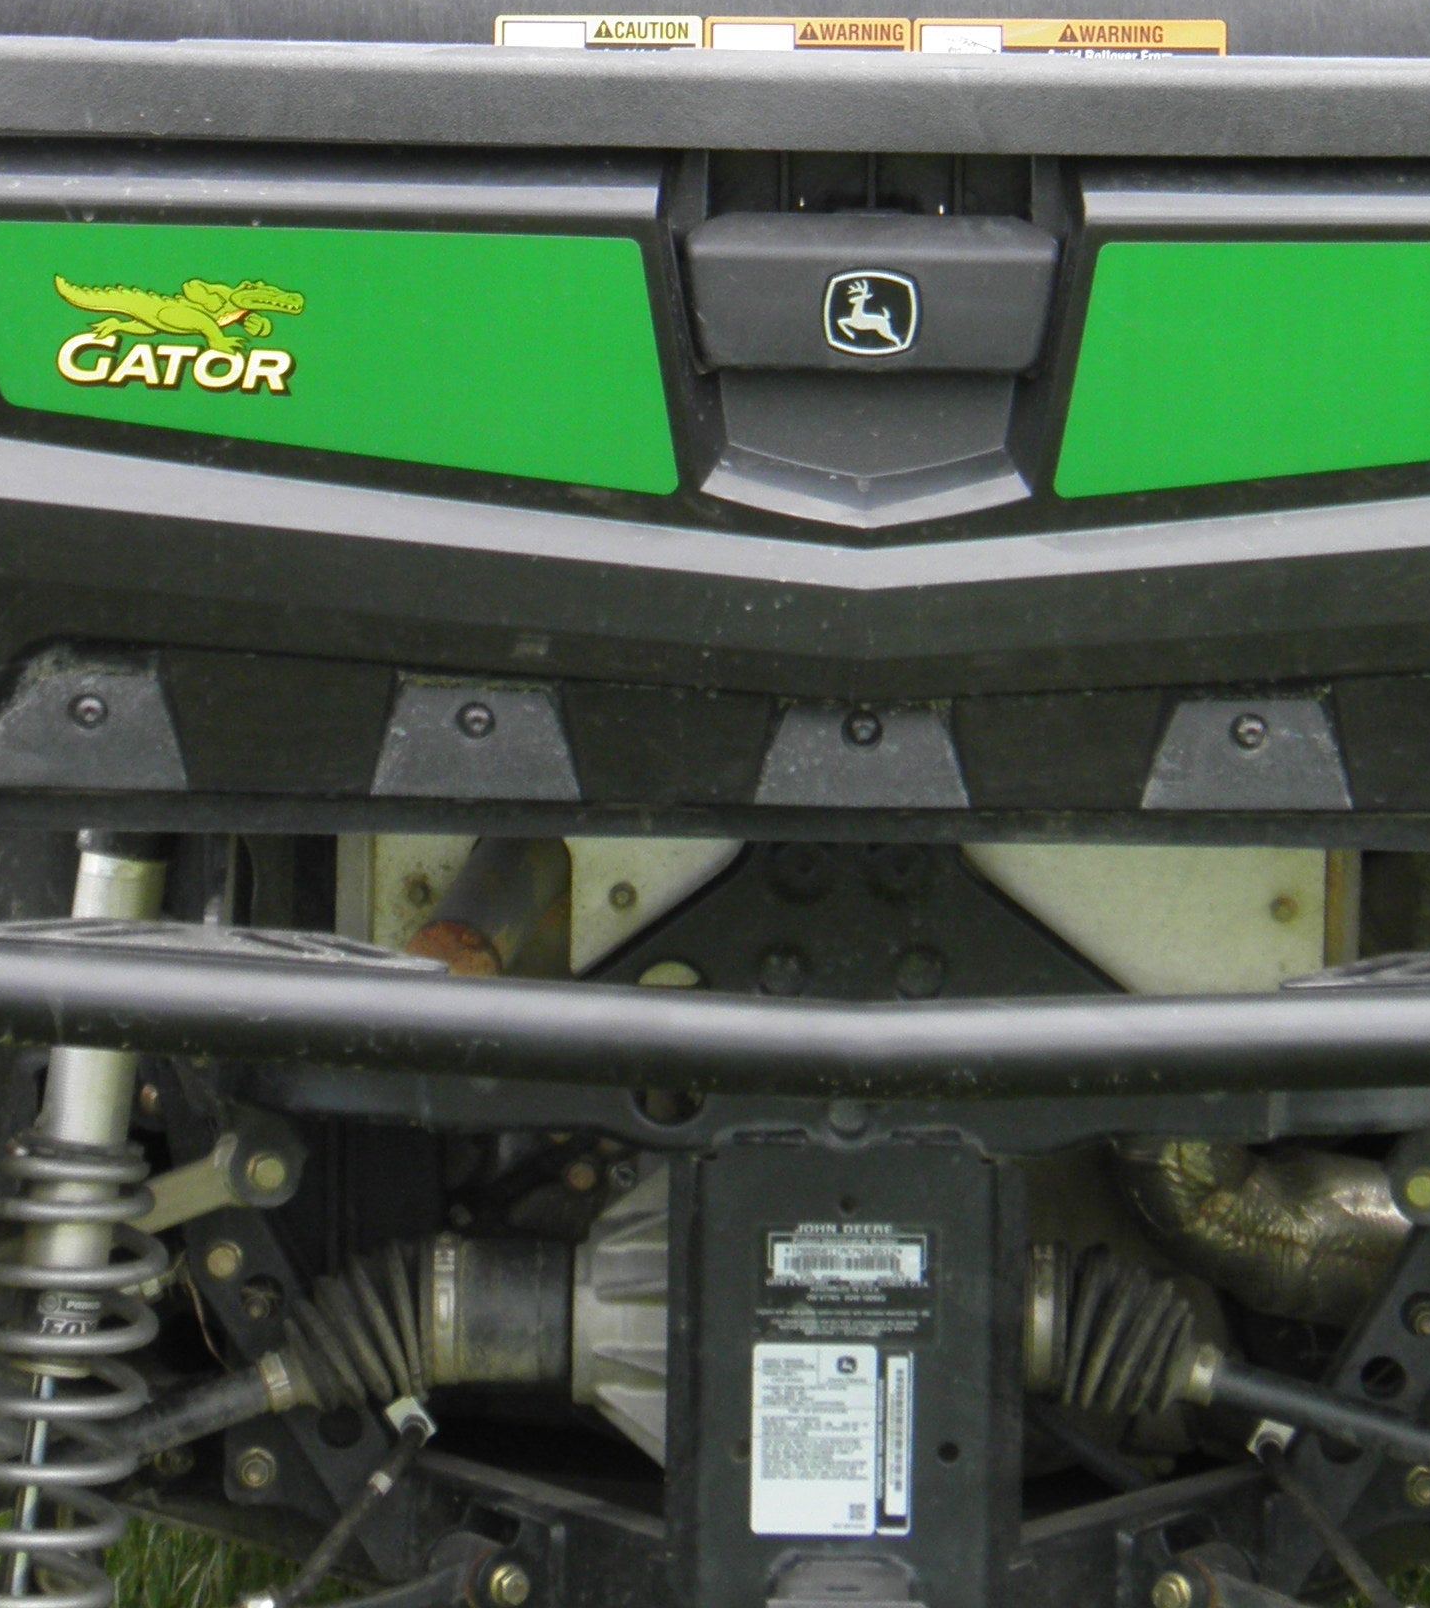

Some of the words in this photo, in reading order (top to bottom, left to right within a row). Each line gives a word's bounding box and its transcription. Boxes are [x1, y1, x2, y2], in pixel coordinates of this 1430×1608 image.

[614, 21, 689, 40] CAUTION
[819, 23, 904, 41] WARNING
[1079, 25, 1164, 43] WARNING
[56, 332, 296, 395] GATOR
[796, 1223, 838, 1235] JOHN
